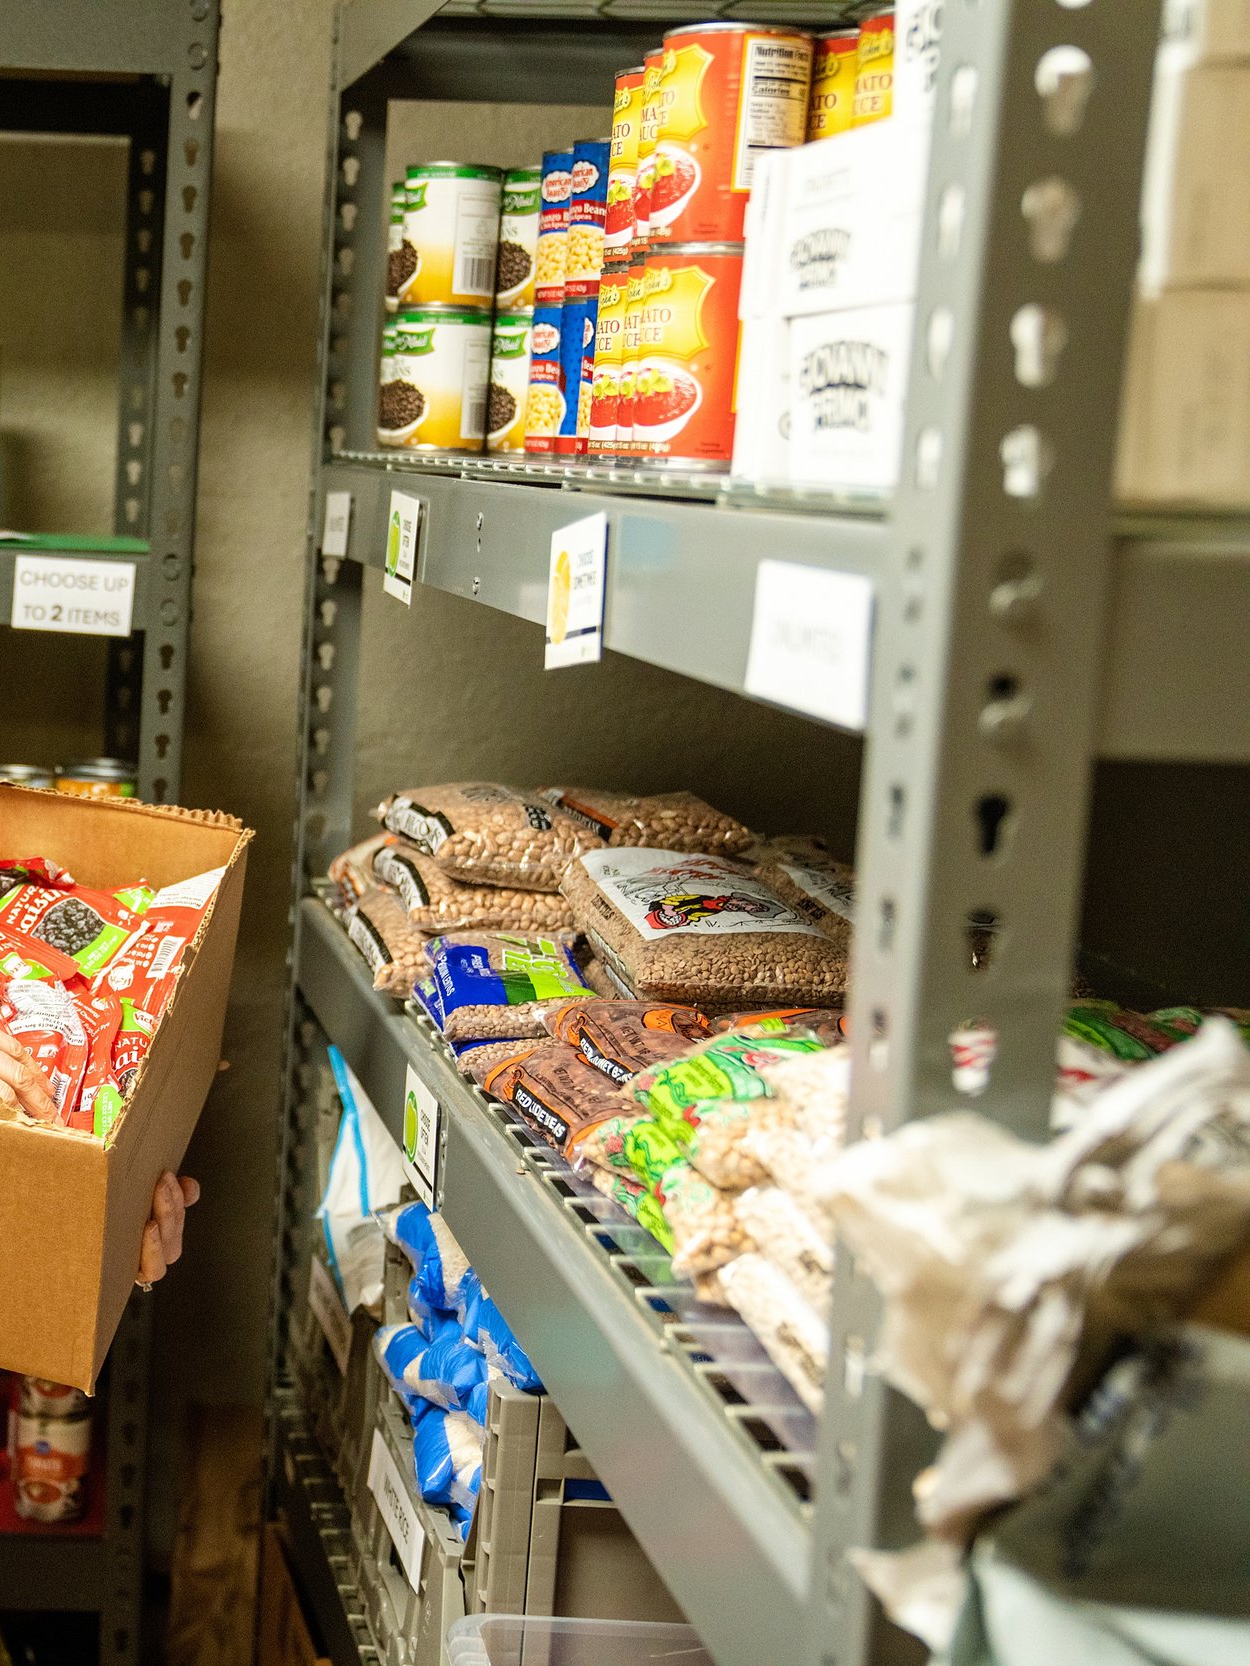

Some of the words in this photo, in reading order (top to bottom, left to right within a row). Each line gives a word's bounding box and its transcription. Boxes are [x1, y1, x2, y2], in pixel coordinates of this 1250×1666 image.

[752, 85, 790, 97] Calories
[20, 570, 99, 591] CHOOSE
[103, 575, 129, 592] UP
[22, 604, 45, 621] TO
[51, 604, 63, 622] 2
[67, 607, 120, 626] ITEMS
[591, 893, 615, 920] LENTILS
[512, 1088, 533, 1109] RED
